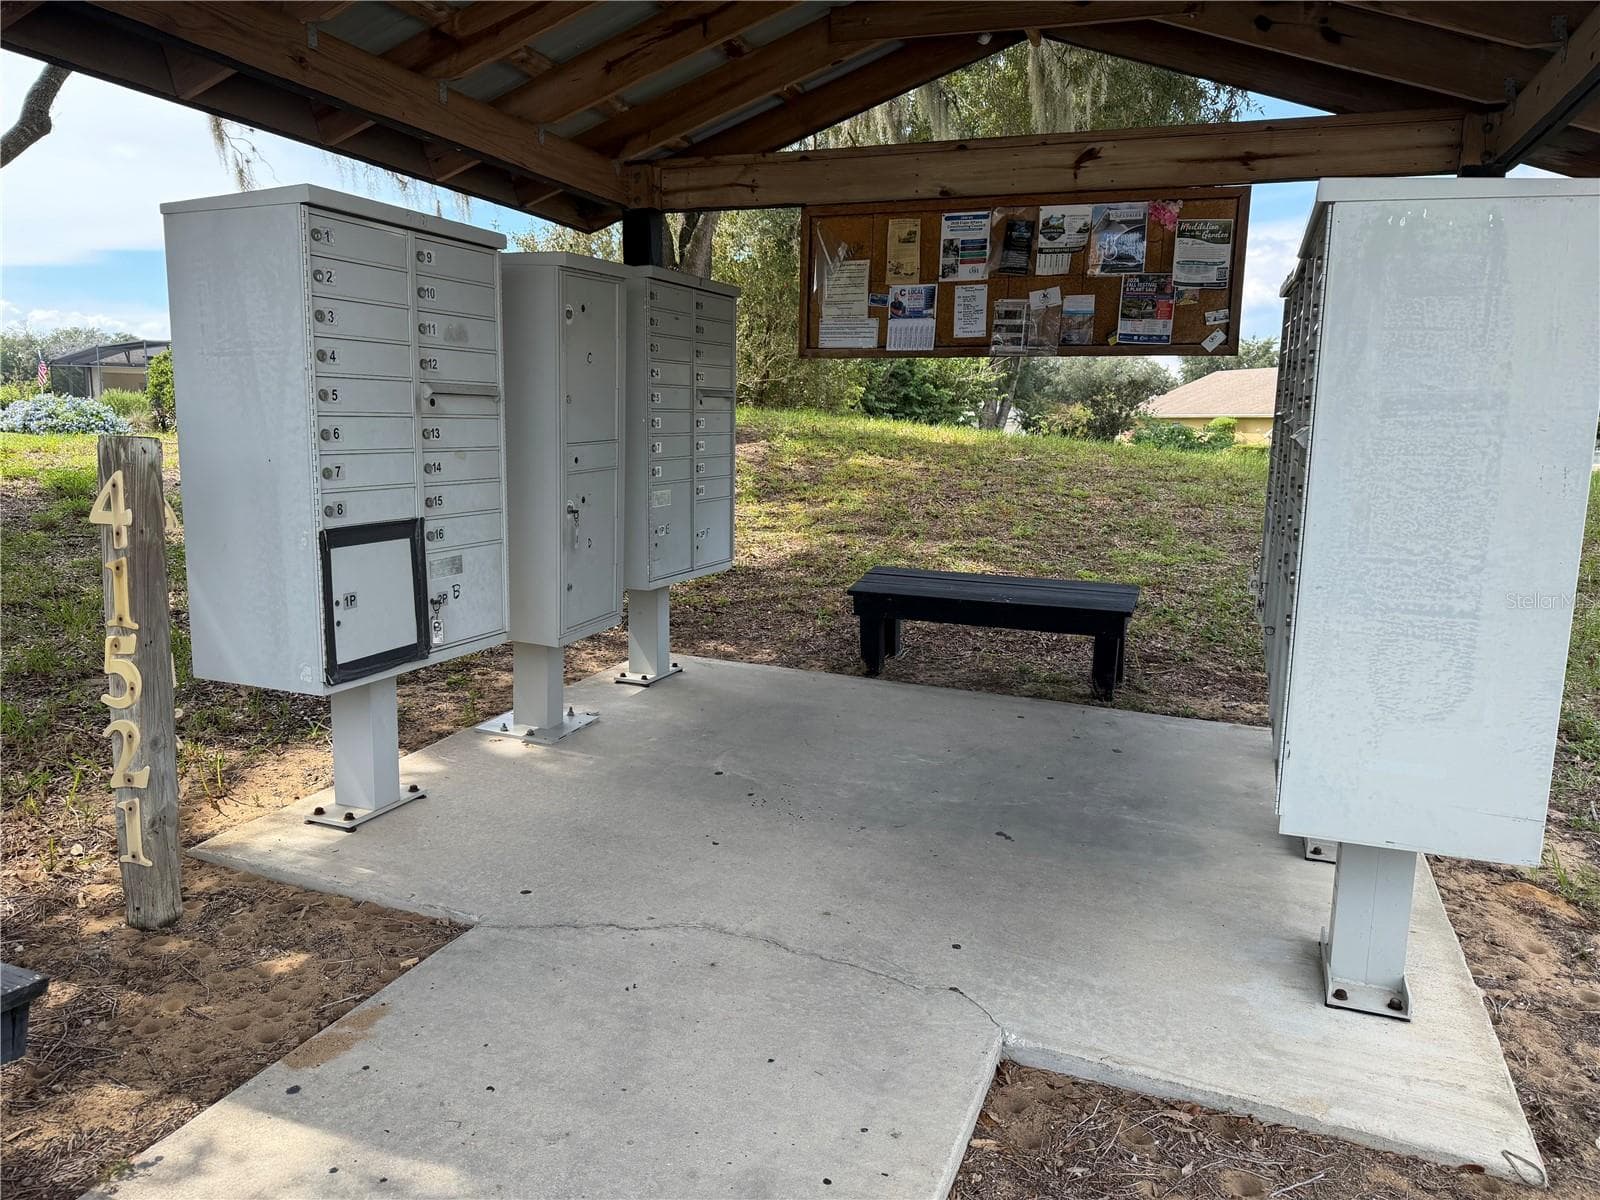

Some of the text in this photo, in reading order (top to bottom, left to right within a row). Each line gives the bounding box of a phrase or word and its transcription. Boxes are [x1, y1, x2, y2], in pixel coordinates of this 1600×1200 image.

[324, 230, 330, 242] 1
[426, 252, 432, 263] 9
[326, 271, 333, 283] 2
[426, 288, 435, 299] 10
[328, 310, 334, 323] 3
[427, 324, 436, 335] 11
[329, 350, 336, 362] 4
[428, 358, 438, 370] 12
[332, 389, 338, 401] 5
[333, 428, 340, 440] 6
[430, 428, 440, 439] 13
[335, 466, 341, 478] 7
[432, 462, 441, 473] 14
[433, 496, 443, 506] 15
[336, 504, 344, 516] 8
[434, 528, 444, 539] 16
[452, 584, 461, 600] B
[344, 594, 356, 607] 1P
